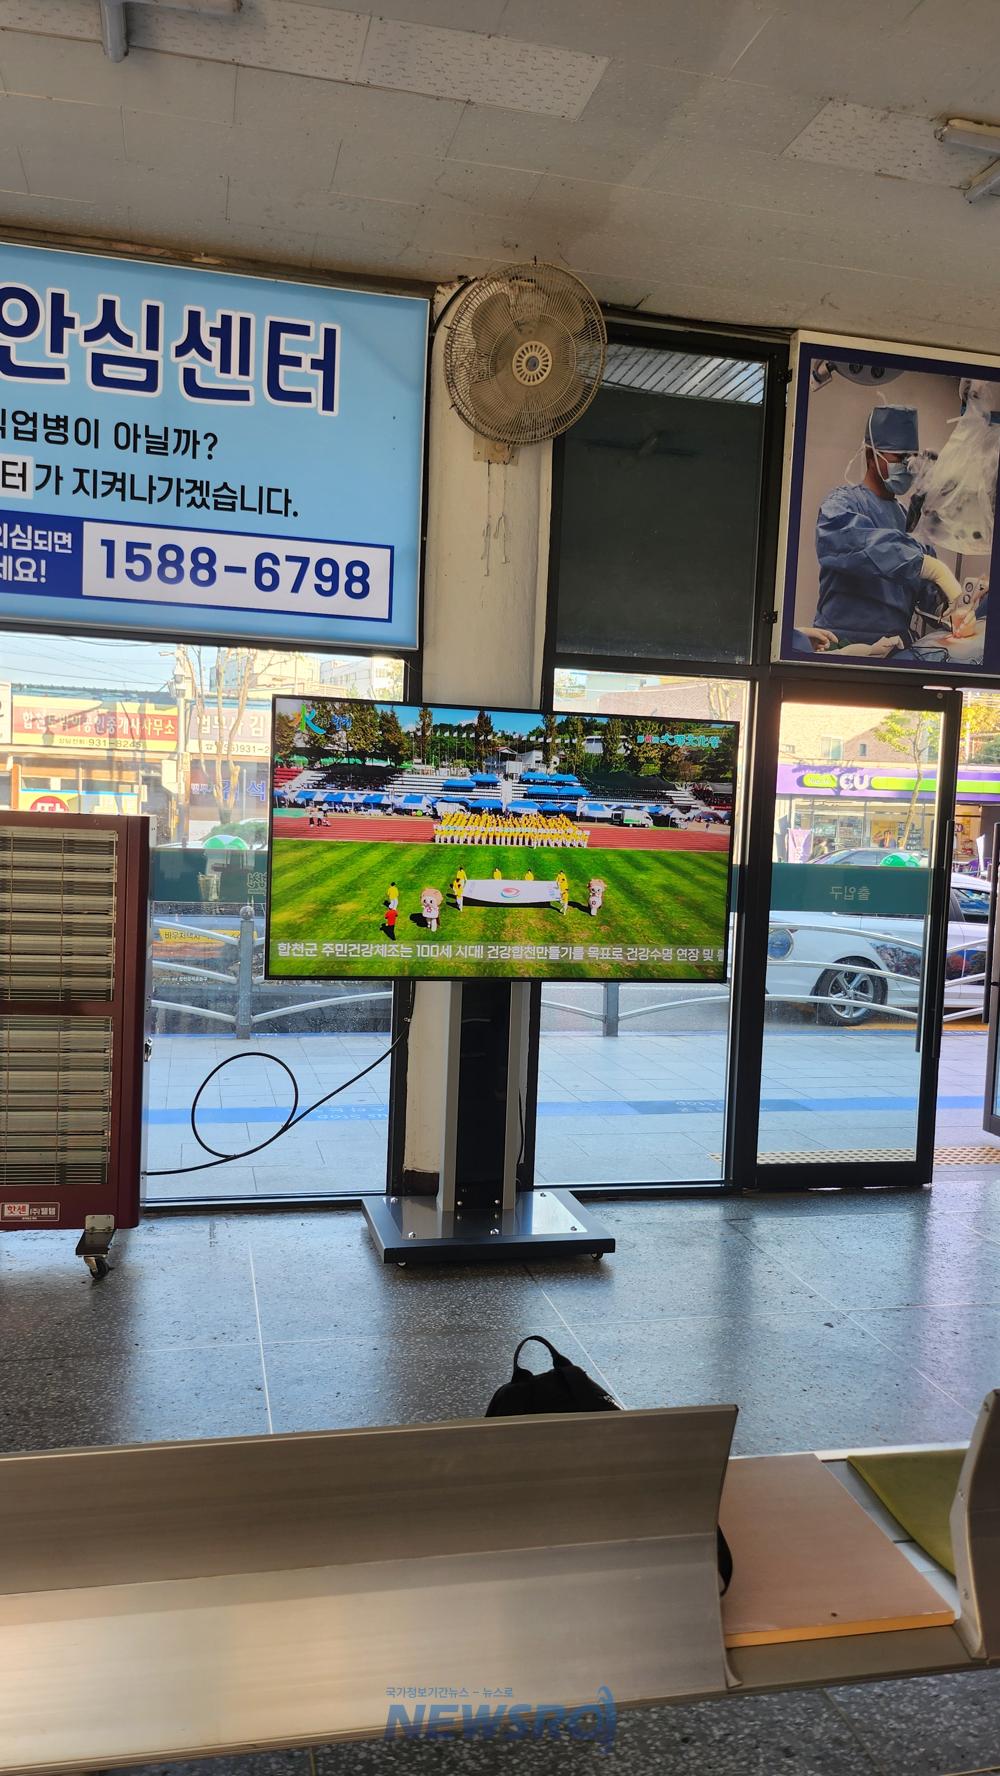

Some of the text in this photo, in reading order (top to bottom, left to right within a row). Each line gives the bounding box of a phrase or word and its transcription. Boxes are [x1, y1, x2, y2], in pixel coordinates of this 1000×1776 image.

[0, 284, 341, 416] 안심센터
[0, 408, 219, 461] 업병이 아닐까?
[72, 467, 299, 518] 지켜나가겠습니다.
[100, 537, 371, 600] 1588-6798
[840, 773, 869, 790] CU
[278, 943, 317, 957] 합천군
[322, 944, 412, 958] 주민건강체조는
[416, 945, 452, 958] 100세
[455, 945, 484, 959] 시대!
[487, 945, 585, 960] 건강합천만들기를
[588, 946, 624, 960] 목표로
[626, 947, 673, 961] 건강수명
[676, 948, 699, 961] 연장
[703, 949, 714, 961] 및
